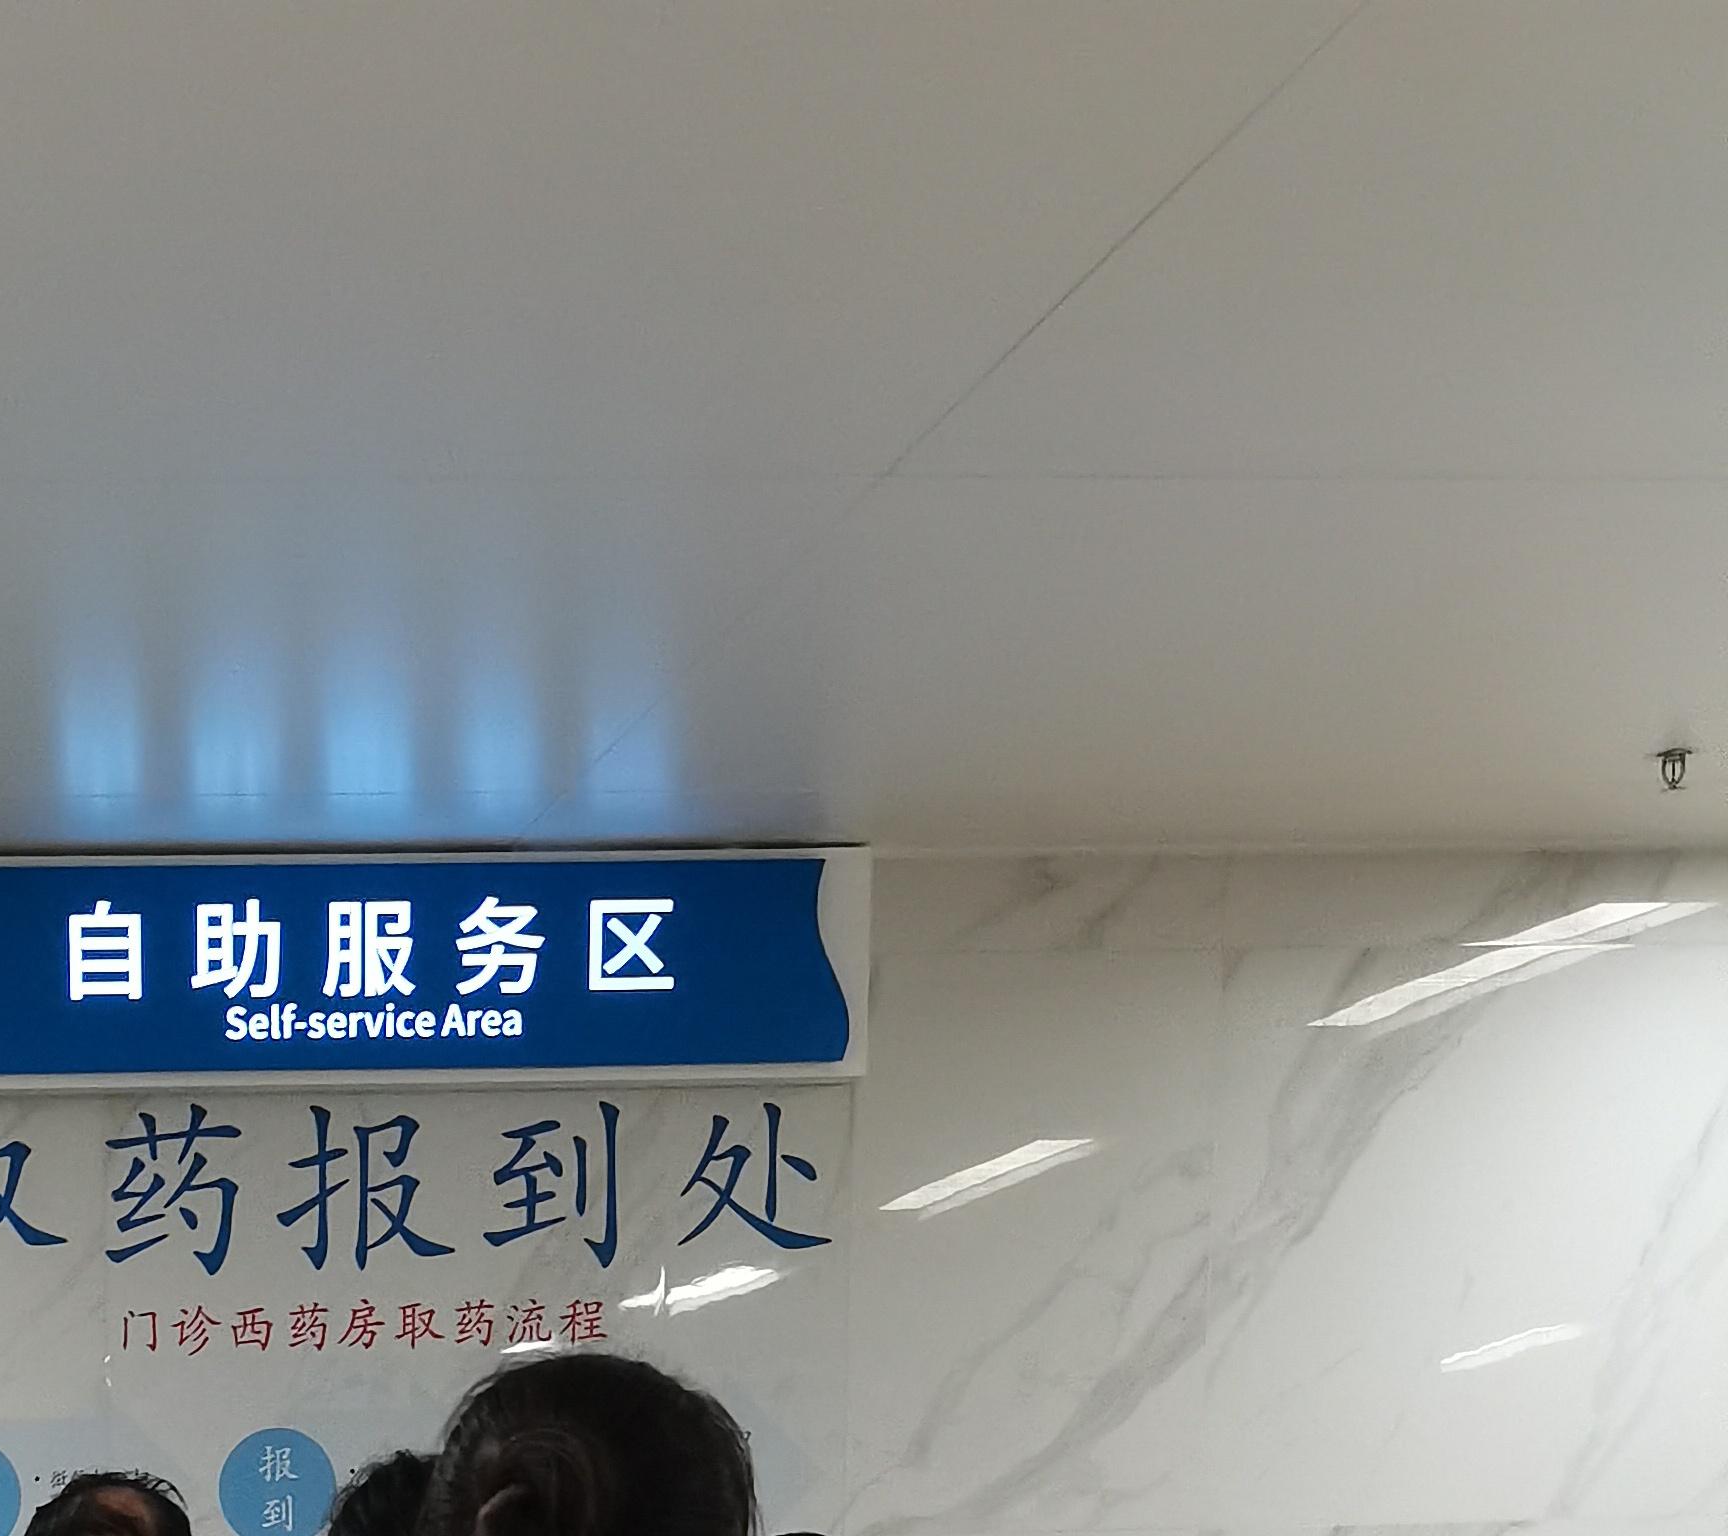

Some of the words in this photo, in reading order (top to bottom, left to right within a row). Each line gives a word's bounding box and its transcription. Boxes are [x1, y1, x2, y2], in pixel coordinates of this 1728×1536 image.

[68, 896, 675, 1000] 自助服务区
[225, 1002, 436, 1040] Self-service
[440, 1003, 523, 1037] Area
[121, 1299, 608, 1356] 门诊西药房取药流程
[258, 1446, 299, 1532] 报到
